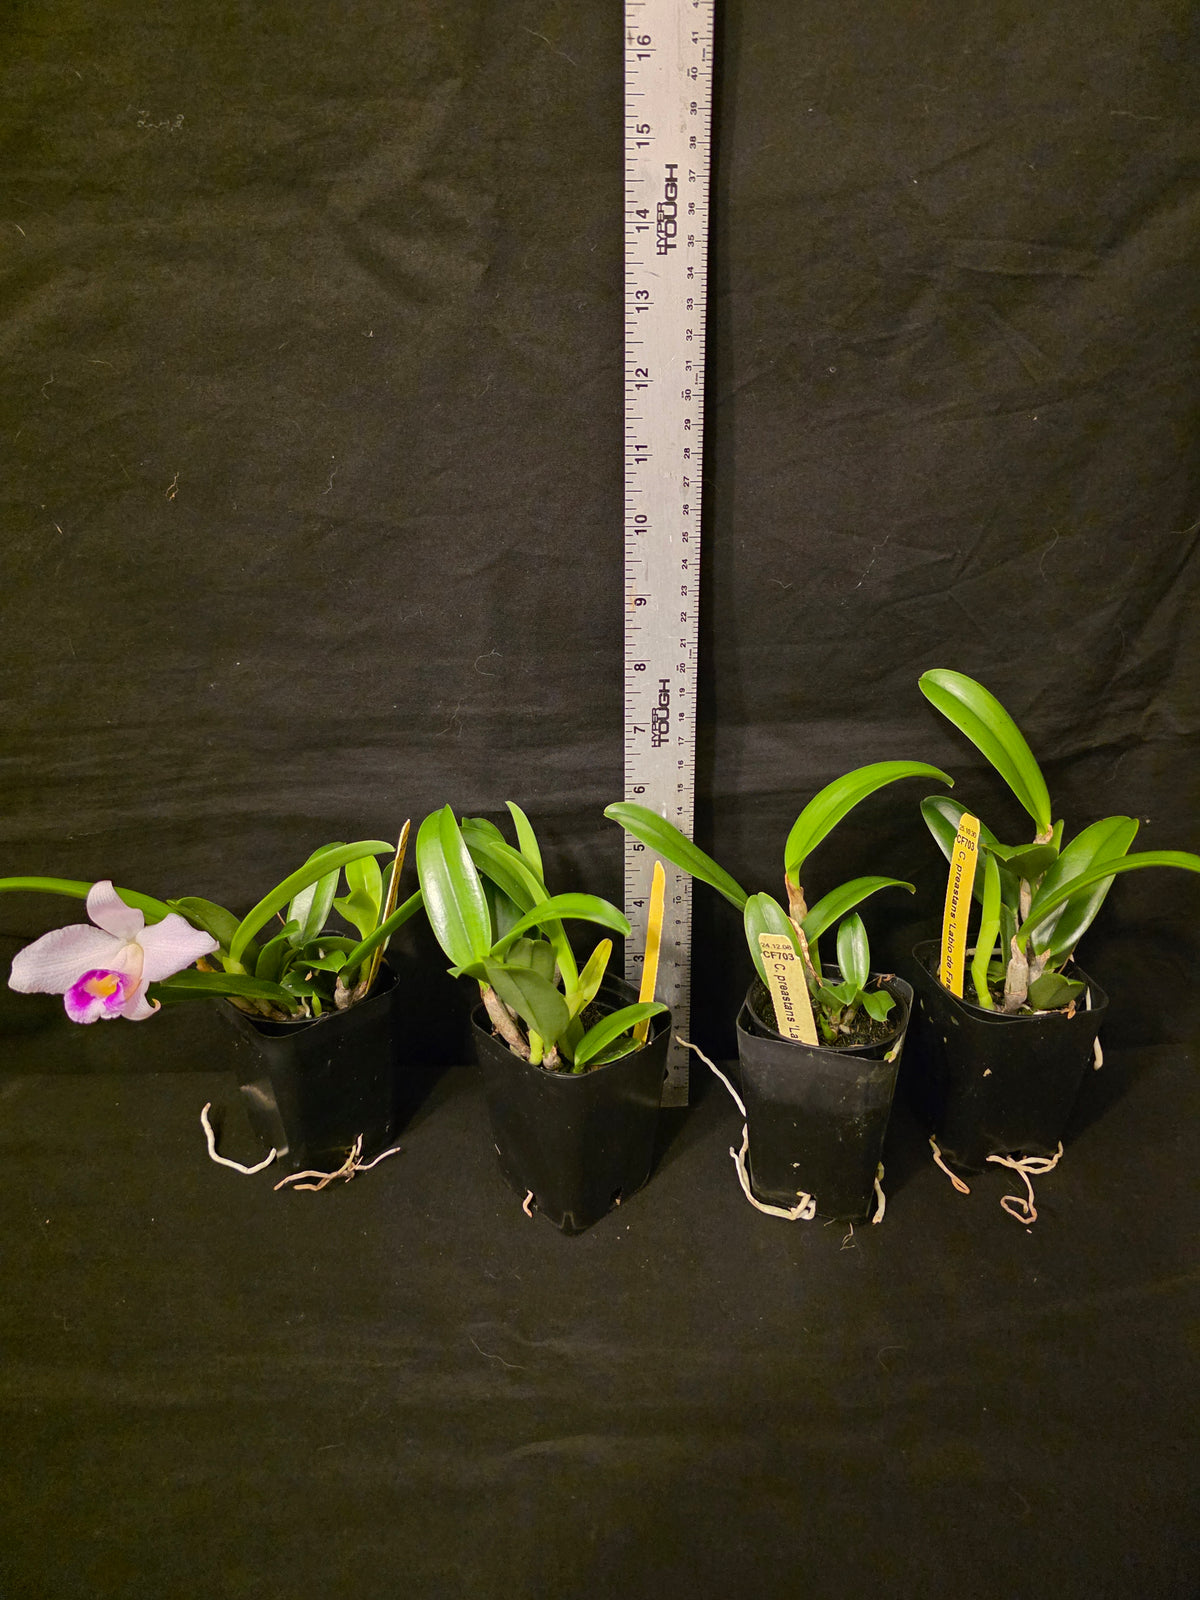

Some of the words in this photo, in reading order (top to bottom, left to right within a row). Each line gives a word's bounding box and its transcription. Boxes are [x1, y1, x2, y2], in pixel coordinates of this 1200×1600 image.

[692, 31, 699, 44] 41
[637, 34, 651, 61] 16
[691, 67, 698, 81] 40
[691, 102, 697, 115] 39
[636, 123, 651, 149] 15
[690, 136, 697, 150] 38
[689, 169, 696, 183] 37
[664, 164, 678, 249] TOUGH
[688, 203, 695, 216] 36
[636, 208, 649, 233] 14
[657, 202, 668, 256] HYPER
[688, 235, 695, 248] 35
[687, 266, 694, 279] 34
[636, 290, 649, 313] 13
[687, 298, 694, 311] 33
[686, 328, 693, 341] 32
[686, 360, 692, 371] 31
[636, 368, 649, 390] 12
[685, 389, 692, 401] 30
[685, 419, 691, 430] 29
[635, 444, 648, 464] 11
[684, 448, 690, 459] 28
[683, 476, 690, 487] 27
[683, 504, 689, 515] 26
[635, 514, 648, 535] 10
[682, 532, 689, 543] 25
[682, 559, 688, 570] 24
[681, 586, 688, 596] 23
[634, 598, 647, 607] 9
[681, 612, 687, 623] 22
[680, 638, 687, 648] 21
[634, 663, 646, 672] 8
[679, 663, 686, 673] 20
[679, 688, 685, 698] 19
[659, 679, 670, 743] TOUGH
[679, 712, 685, 722] 18
[634, 726, 645, 734] 7
[652, 708, 662, 748] HYPER
[678, 736, 684, 746] 17
[678, 760, 684, 770] 16
[633, 786, 645, 794] 6
[677, 784, 683, 793] 15
[677, 807, 683, 816] 14
[633, 844, 644, 852] 5
[956, 834, 975, 852] CF703
[675, 875, 681, 883] 11
[951, 864, 963, 920] preastans
[634, 900, 644, 908] 4
[675, 896, 681, 905] 10
[762, 950, 795, 961] CF703
[946, 954, 954, 969] de
[774, 964, 786, 973] C.
[776, 974, 795, 1023] preastans
